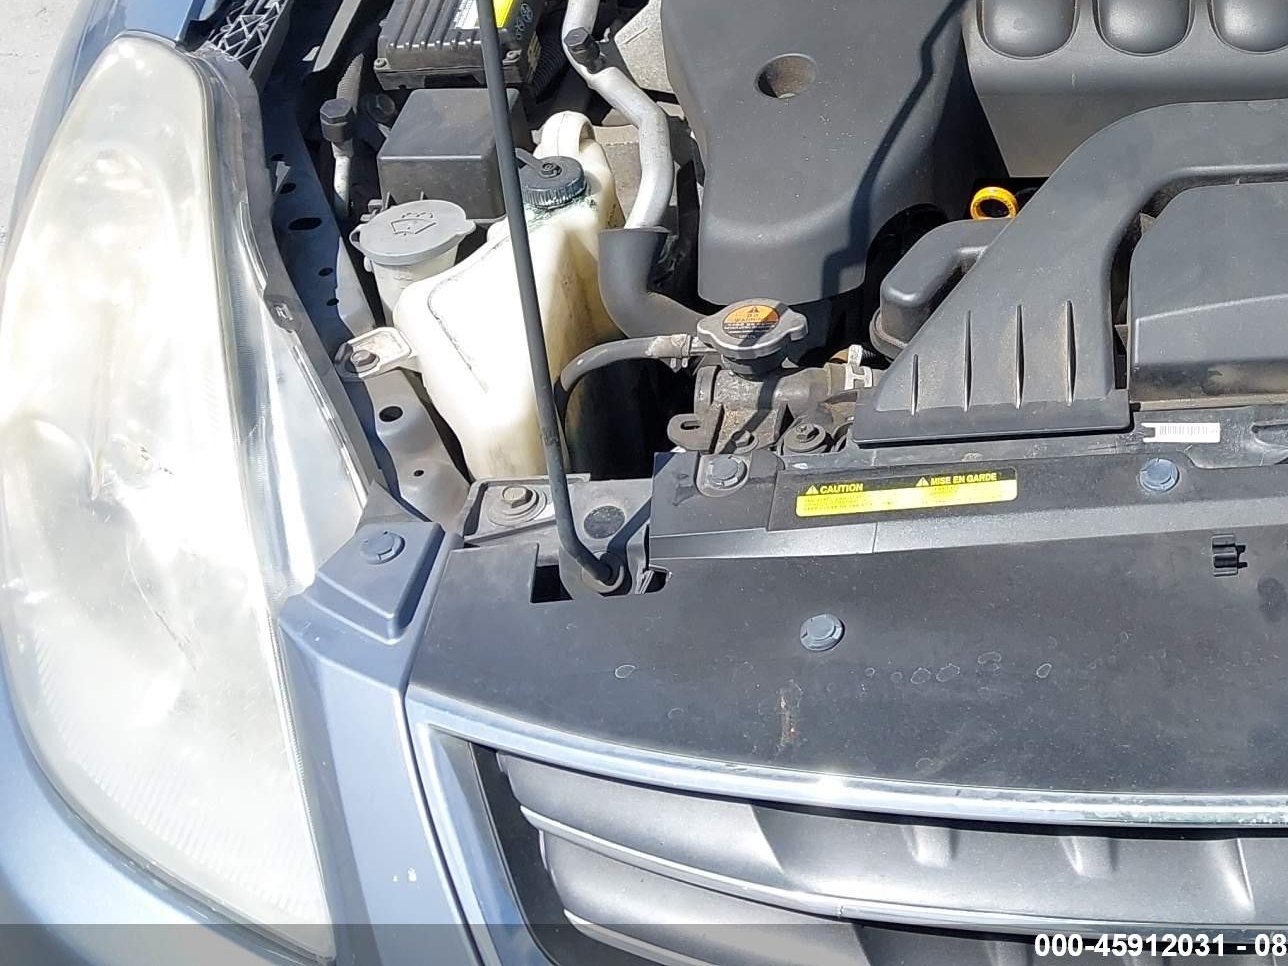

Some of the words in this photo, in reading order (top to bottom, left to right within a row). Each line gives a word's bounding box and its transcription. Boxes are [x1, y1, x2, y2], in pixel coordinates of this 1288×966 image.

[930, 477, 951, 486] MISE
[952, 476, 966, 484] EN
[966, 473, 997, 482] GARDE
[820, 484, 864, 494] CAUTION
